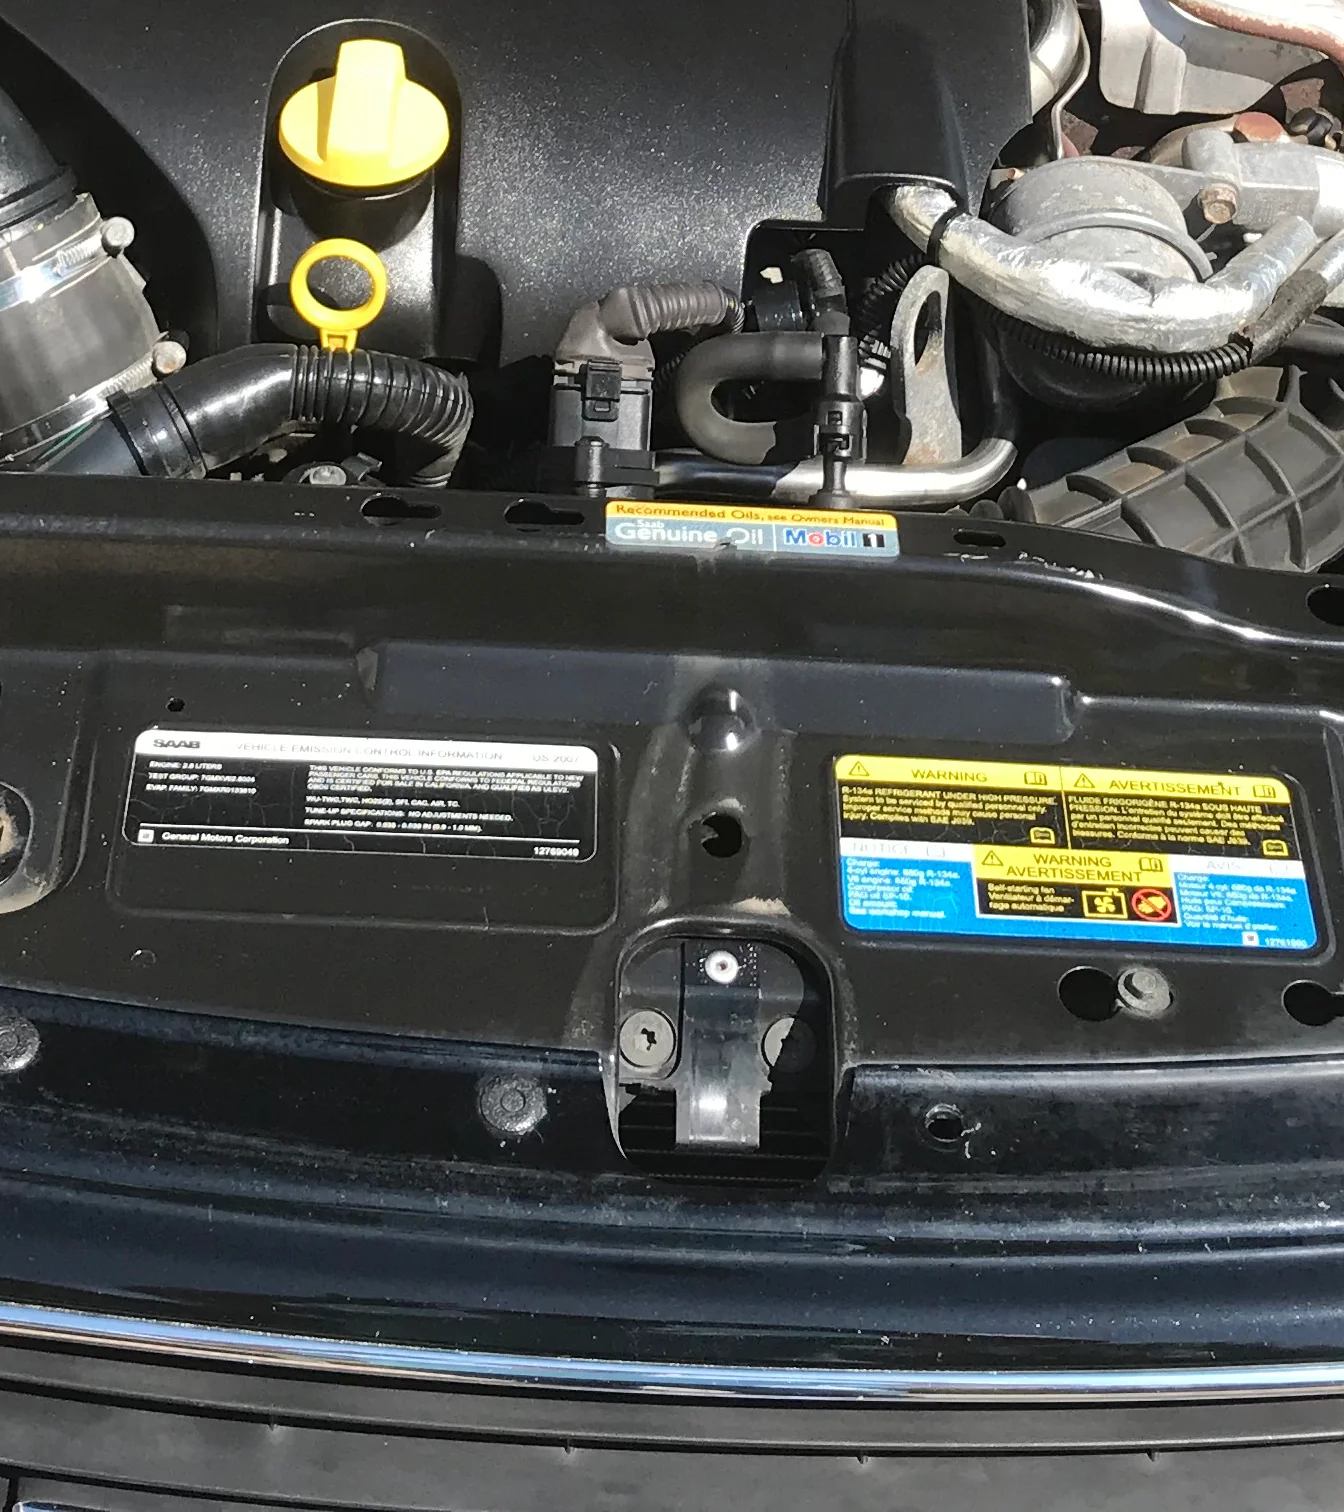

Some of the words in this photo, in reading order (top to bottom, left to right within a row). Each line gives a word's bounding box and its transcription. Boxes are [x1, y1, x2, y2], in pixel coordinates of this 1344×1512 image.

[616, 503, 725, 519] Recommended
[731, 508, 764, 522] Oils,
[767, 514, 787, 522] see
[791, 513, 839, 525] Owners
[843, 516, 885, 526] Manual
[636, 519, 664, 529] Saab
[615, 522, 718, 543] Genuine
[726, 527, 763, 545] Oil
[785, 528, 856, 548] Mobil
[153, 739, 200, 748] SAAB
[236, 743, 288, 752] VEHICLE
[292, 745, 351, 754] EMISSION
[356, 747, 414, 756] CONTROL
[419, 749, 503, 760] INFORMATION
[149, 760, 181, 768] ENGINE:
[335, 778, 375, 786] CERTIFIED
[434, 776, 478, 784] CONFORMS
[527, 780, 581, 788] REGULATIONS
[911, 769, 987, 782] WARNING
[168, 784, 198, 792] FAMILY:
[842, 786, 873, 796] R-134a
[875, 787, 941, 799] REFRIGERANT
[943, 791, 977, 801] UNDER
[978, 793, 1002, 802] HIGH
[1109, 780, 1242, 796] AVERTISSEMENT
[842, 794, 874, 804] System
[885, 796, 897, 805] be
[899, 797, 934, 807] serviced
[935, 799, 947, 809] by
[947, 800, 983, 810] qualified
[985, 802, 1026, 812] personnel
[1028, 805, 1047, 815] only.
[1068, 795, 1101, 805] FLUIDE
[1170, 801, 1201, 810] R-134a
[1202, 803, 1229, 812] SOUS
[1231, 805, 1262, 814] HAUTE
[305, 807, 339, 815] TUNE-UP
[340, 808, 405, 817] SPECIFICATIONS:
[421, 812, 478, 820] ADJUSTMENTS
[479, 813, 514, 821] NEEDED.
[843, 803, 881, 814] Improper
[882, 805, 912, 813] service
[914, 806, 950, 816] methods
[952, 810, 970, 818] may
[972, 811, 998, 819] cause
[999, 811, 1036, 821] personal
[870, 812, 909, 823] Complies
[911, 814, 929, 823] with
[930, 816, 949, 824] SAE
[1069, 803, 1120, 814] PRESSION.
[1121, 806, 1165, 817] L'entretien
[1167, 808, 1178, 817] du
[1216, 812, 1232, 820] doit
[1233, 813, 1250, 821] être
[1071, 812, 1084, 822] par
[1099, 814, 1141, 824] personnel
[1174, 818, 1219, 827] seulement.
[1220, 820, 1238, 828] Des
[1239, 821, 1281, 831] méthodes
[1071, 821, 1115, 830] d'entretien
[1117, 823, 1162, 832] incorrectes
[1164, 825, 1198, 835] peuvent
[1200, 828, 1228, 836] causer
[1230, 829, 1246, 837] des
[1072, 828, 1116, 838] blessures.
[1117, 830, 1159, 841] Conforme
[1178, 835, 1205, 843] norme
[1207, 836, 1225, 844] SAE
[162, 832, 199, 841] General
[200, 833, 234, 842] Motors
[234, 834, 290, 845] Corporation
[534, 847, 579, 857] 12769049
[1033, 853, 1112, 867] WARNING
[1006, 866, 1142, 883] AVERTISSEMENT
[987, 883, 1039, 895] Self-starting
[1040, 886, 1055, 894] fan
[988, 892, 1035, 902] Ventilateur
[1044, 894, 1074, 904] démar-
[989, 902, 1009, 911] rage
[1011, 902, 1065, 913] automatique
